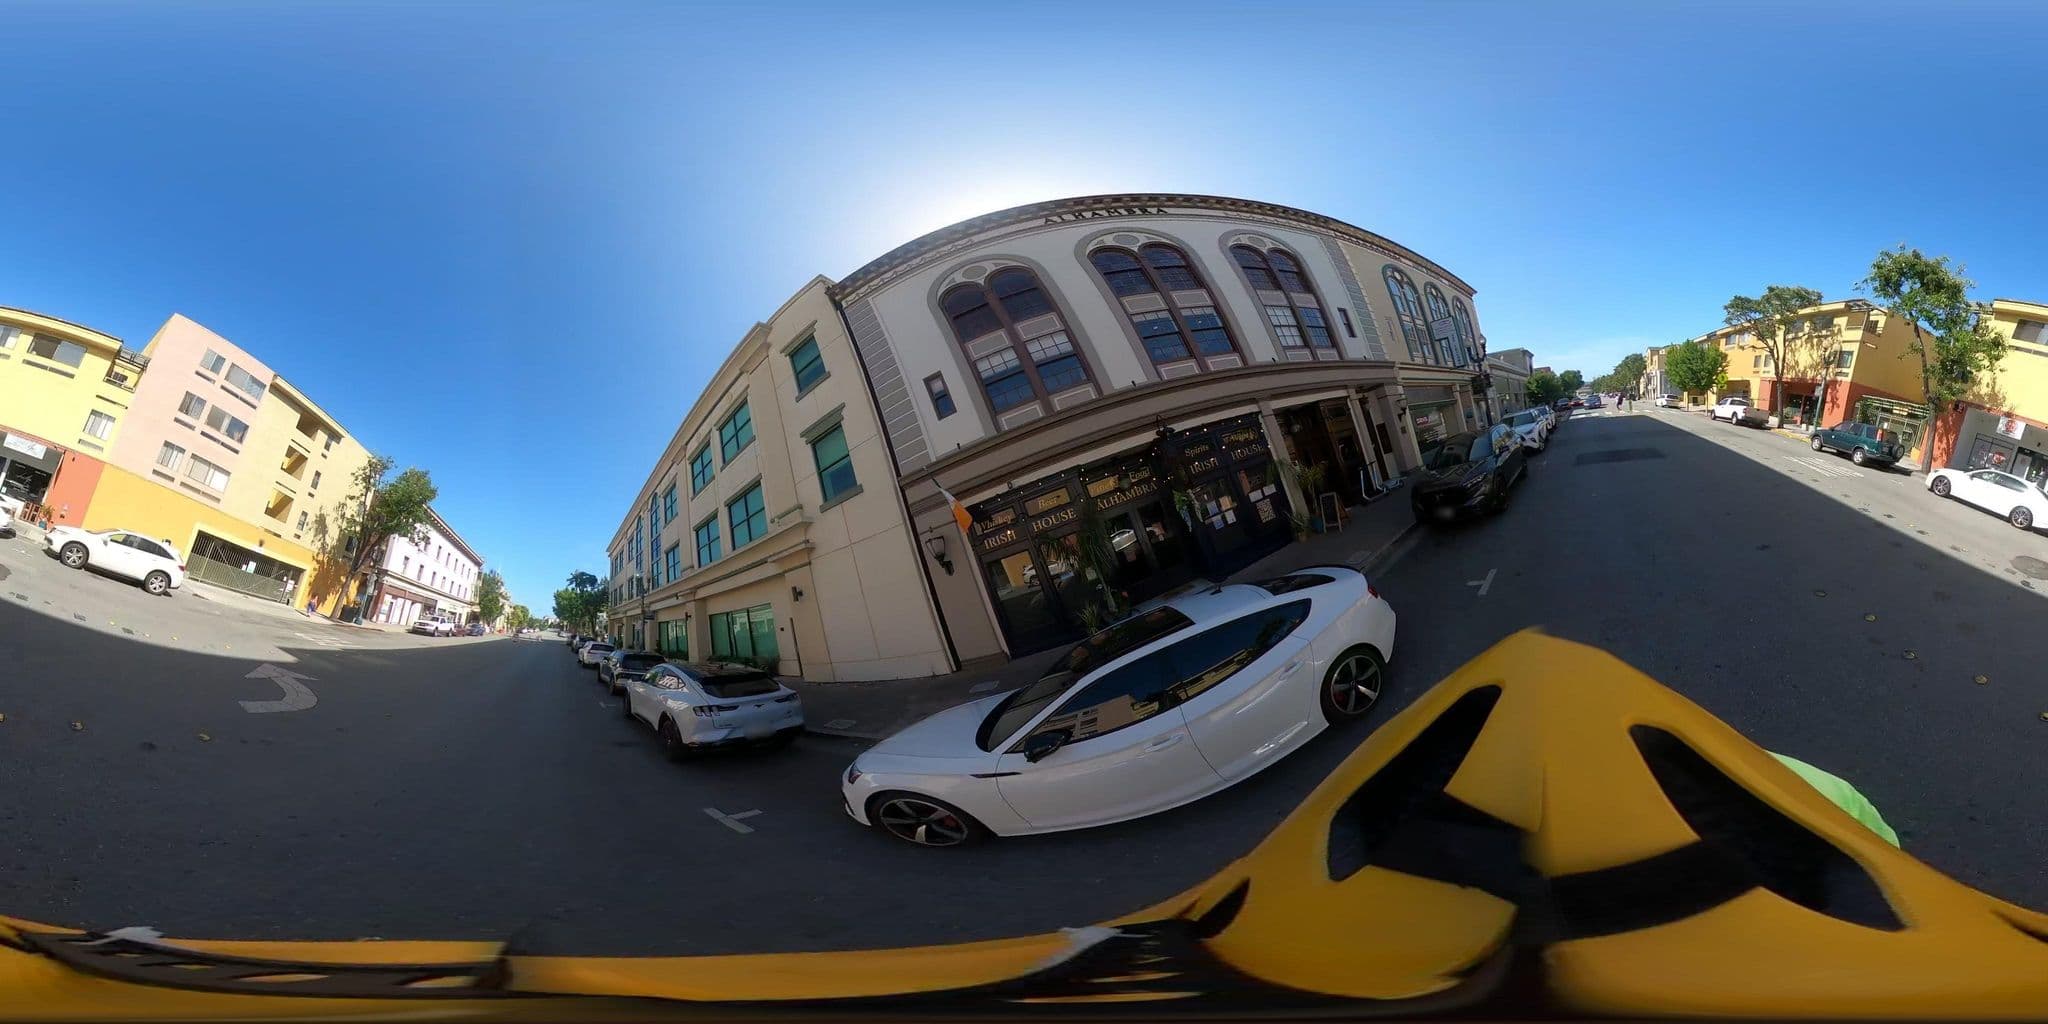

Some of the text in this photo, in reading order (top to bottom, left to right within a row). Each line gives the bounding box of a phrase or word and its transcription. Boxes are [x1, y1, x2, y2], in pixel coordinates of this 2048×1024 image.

[1045, 208, 1167, 224] ALHAMBRA
[1190, 443, 1264, 474] IRISH HOUSE
[1129, 466, 1150, 481] Food
[1097, 482, 1158, 511] ALHAMBRA
[984, 508, 1077, 549] IRISH HOUSE
